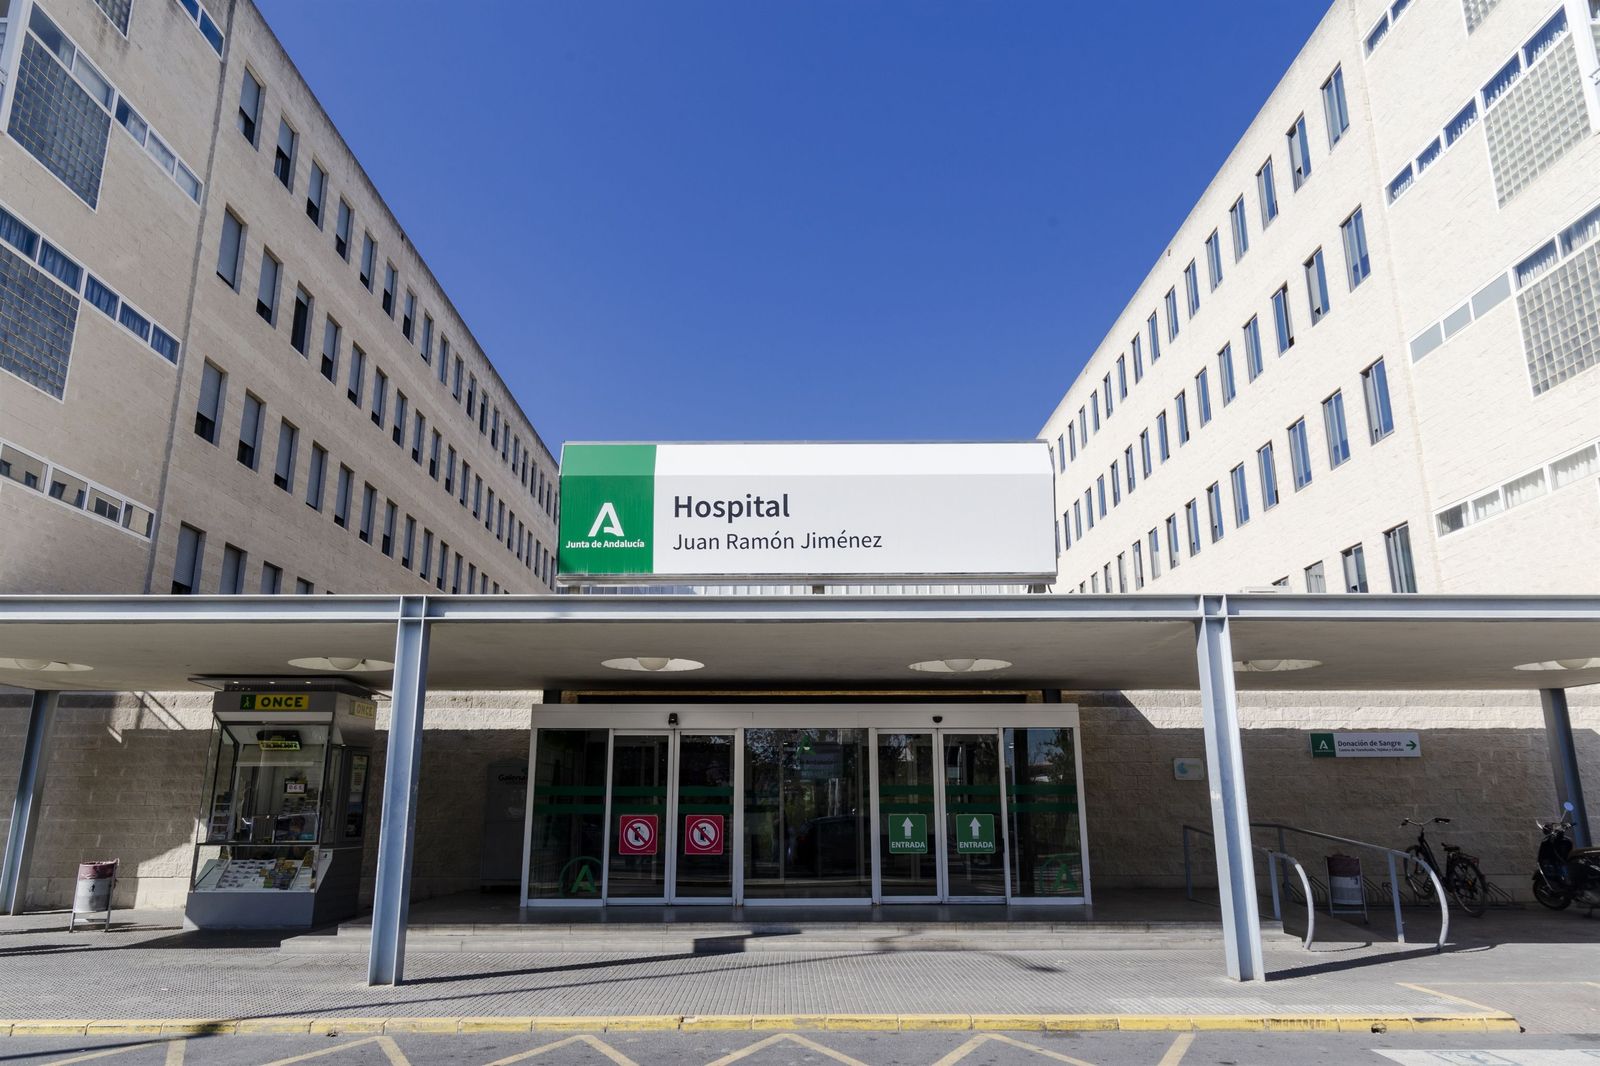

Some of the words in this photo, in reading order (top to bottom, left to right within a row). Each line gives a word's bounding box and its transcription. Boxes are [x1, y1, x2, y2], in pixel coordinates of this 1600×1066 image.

[673, 493, 790, 523] Hospital
[565, 540, 590, 549] Junta
[591, 540, 602, 548] de
[603, 539, 645, 548] Andalucía
[672, 533, 720, 551] Juan
[726, 531, 794, 549] Ramón
[800, 530, 883, 550] Jiménez
[260, 696, 304, 708] ONCE
[356, 703, 373, 717] ONCE
[1337, 739, 1369, 747] Donación
[1378, 740, 1402, 748] Sangre
[891, 841, 926, 849] ENTRADA
[959, 841, 994, 849] ENTRADA
